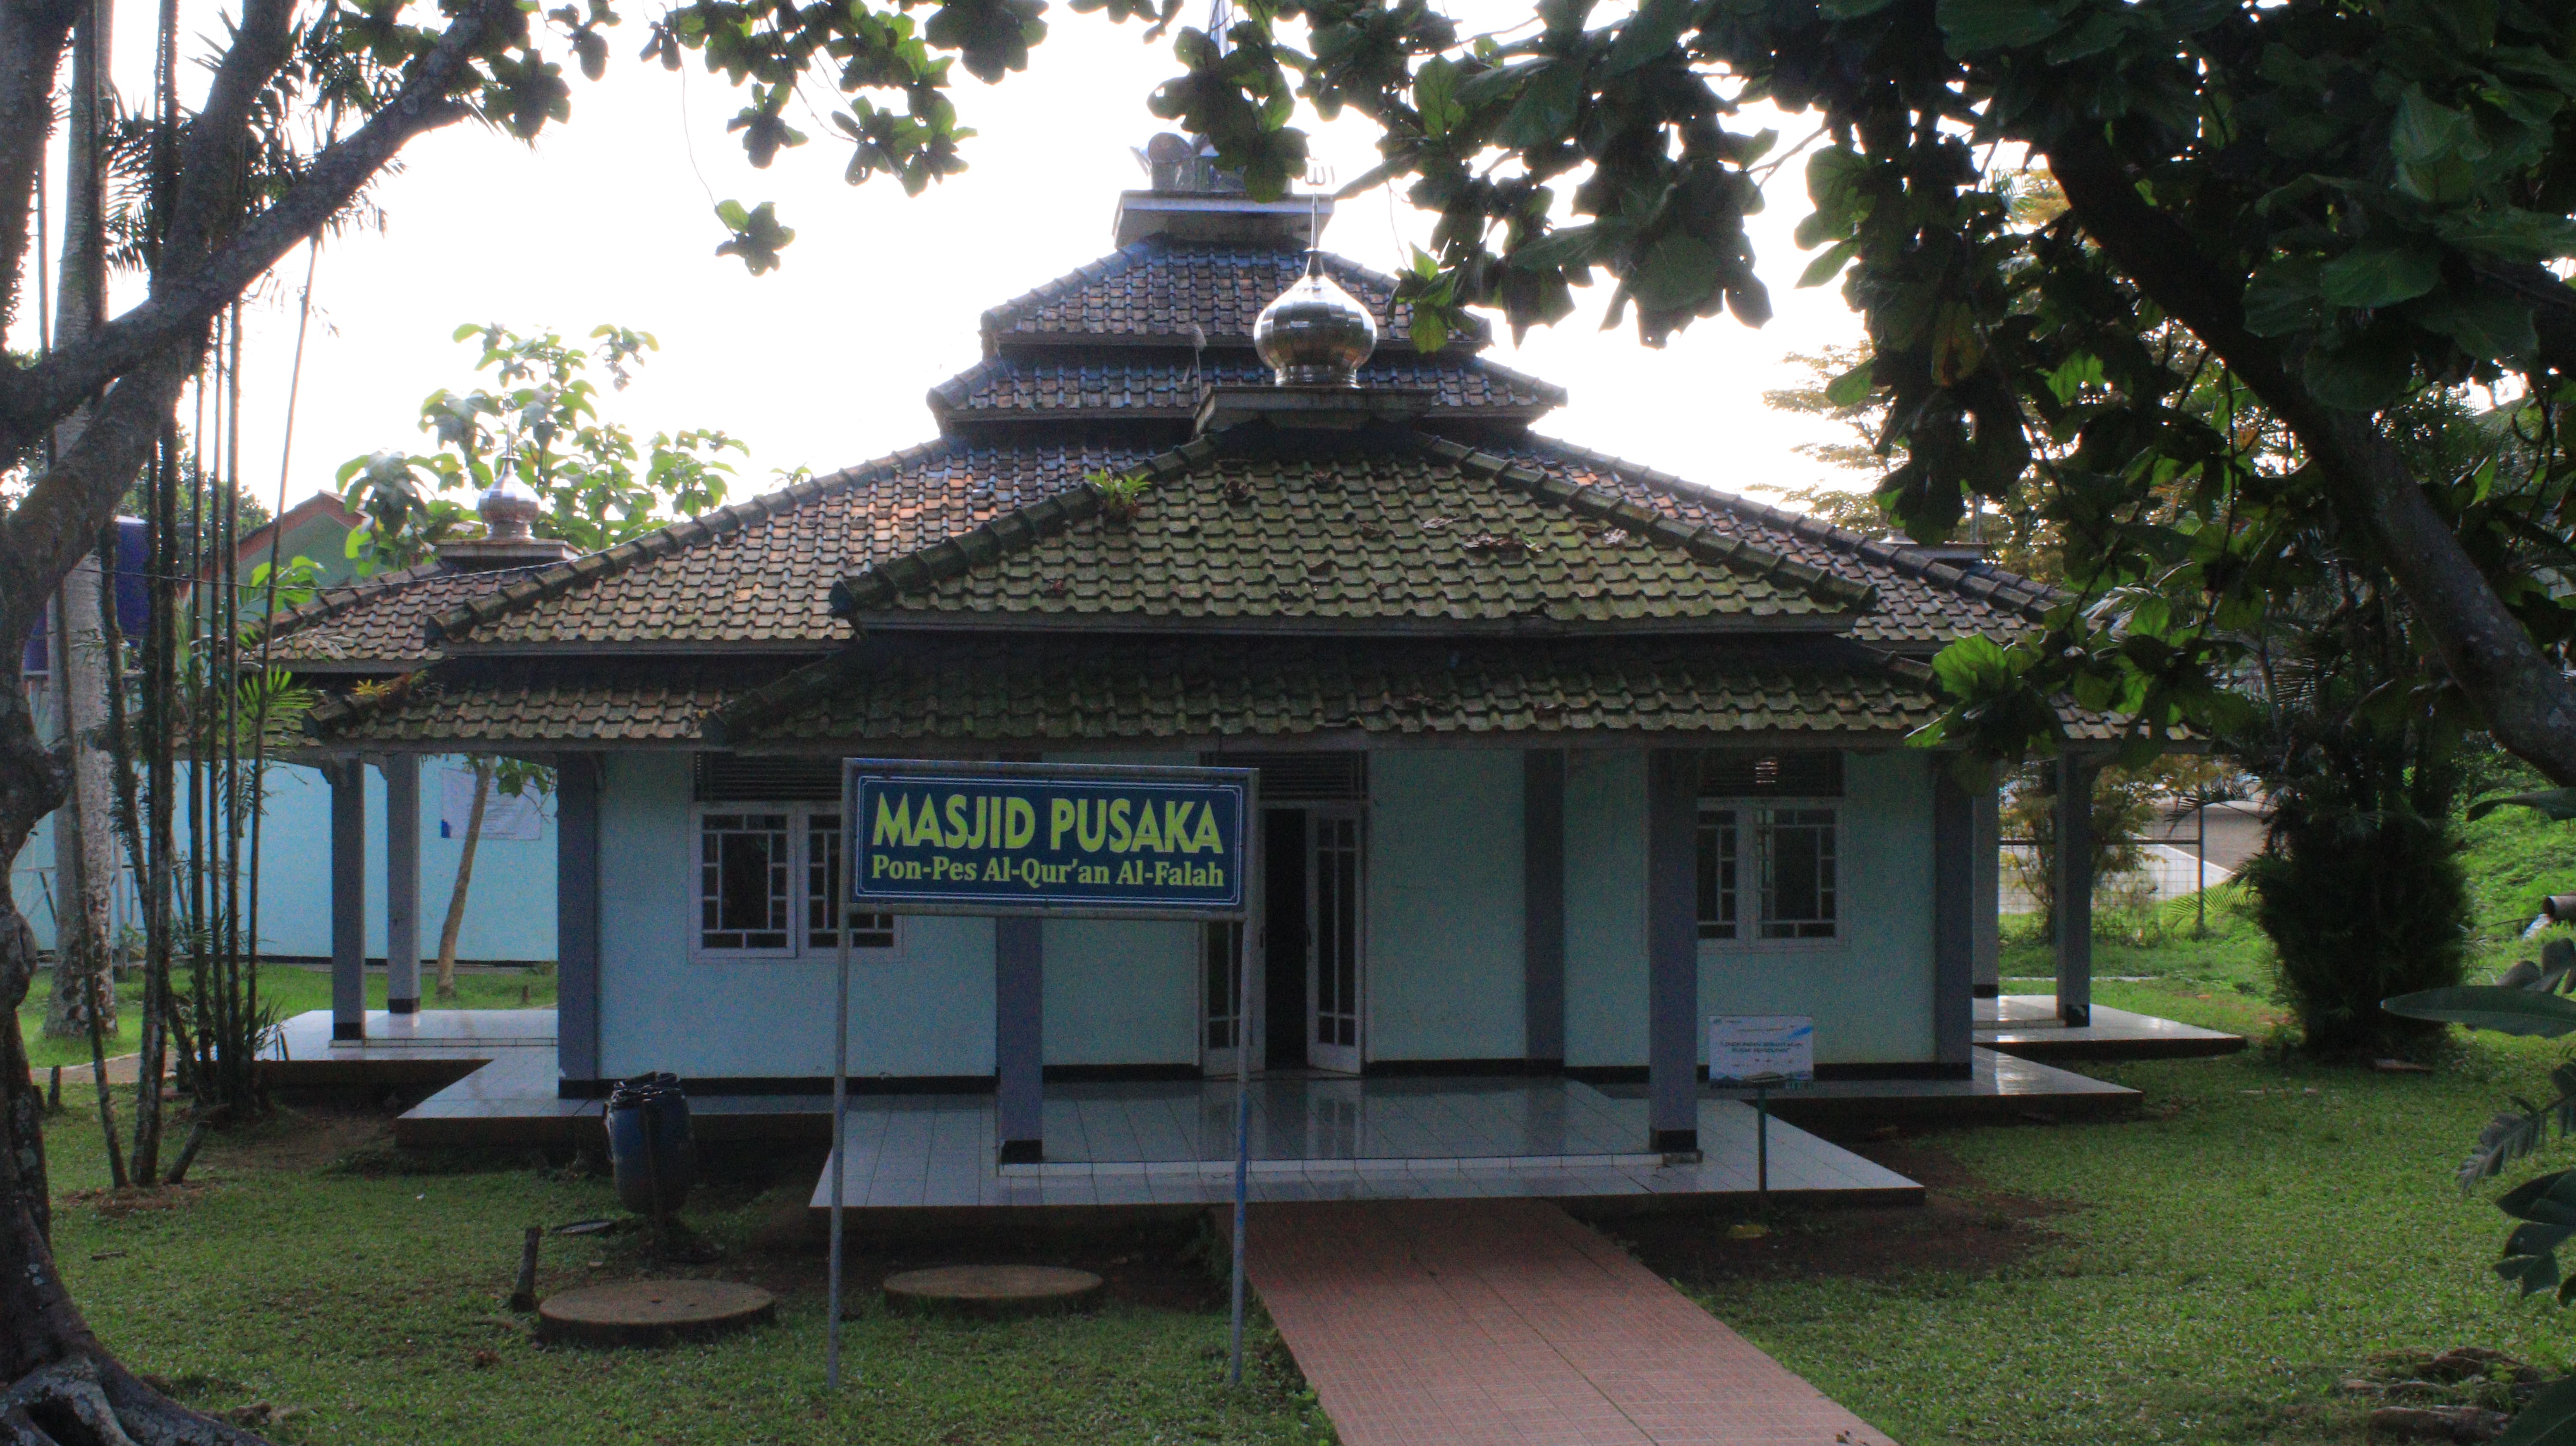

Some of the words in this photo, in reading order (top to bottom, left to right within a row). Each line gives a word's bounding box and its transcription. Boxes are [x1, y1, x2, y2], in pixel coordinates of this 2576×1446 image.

[872, 793, 1035, 849] MASJID
[1050, 798, 1224, 854] PUSAKA
[872, 854, 977, 880] Pon-Pes
[982, 857, 1110, 888] Al-Qur'an
[1117, 860, 1224, 887] Al-Falah
